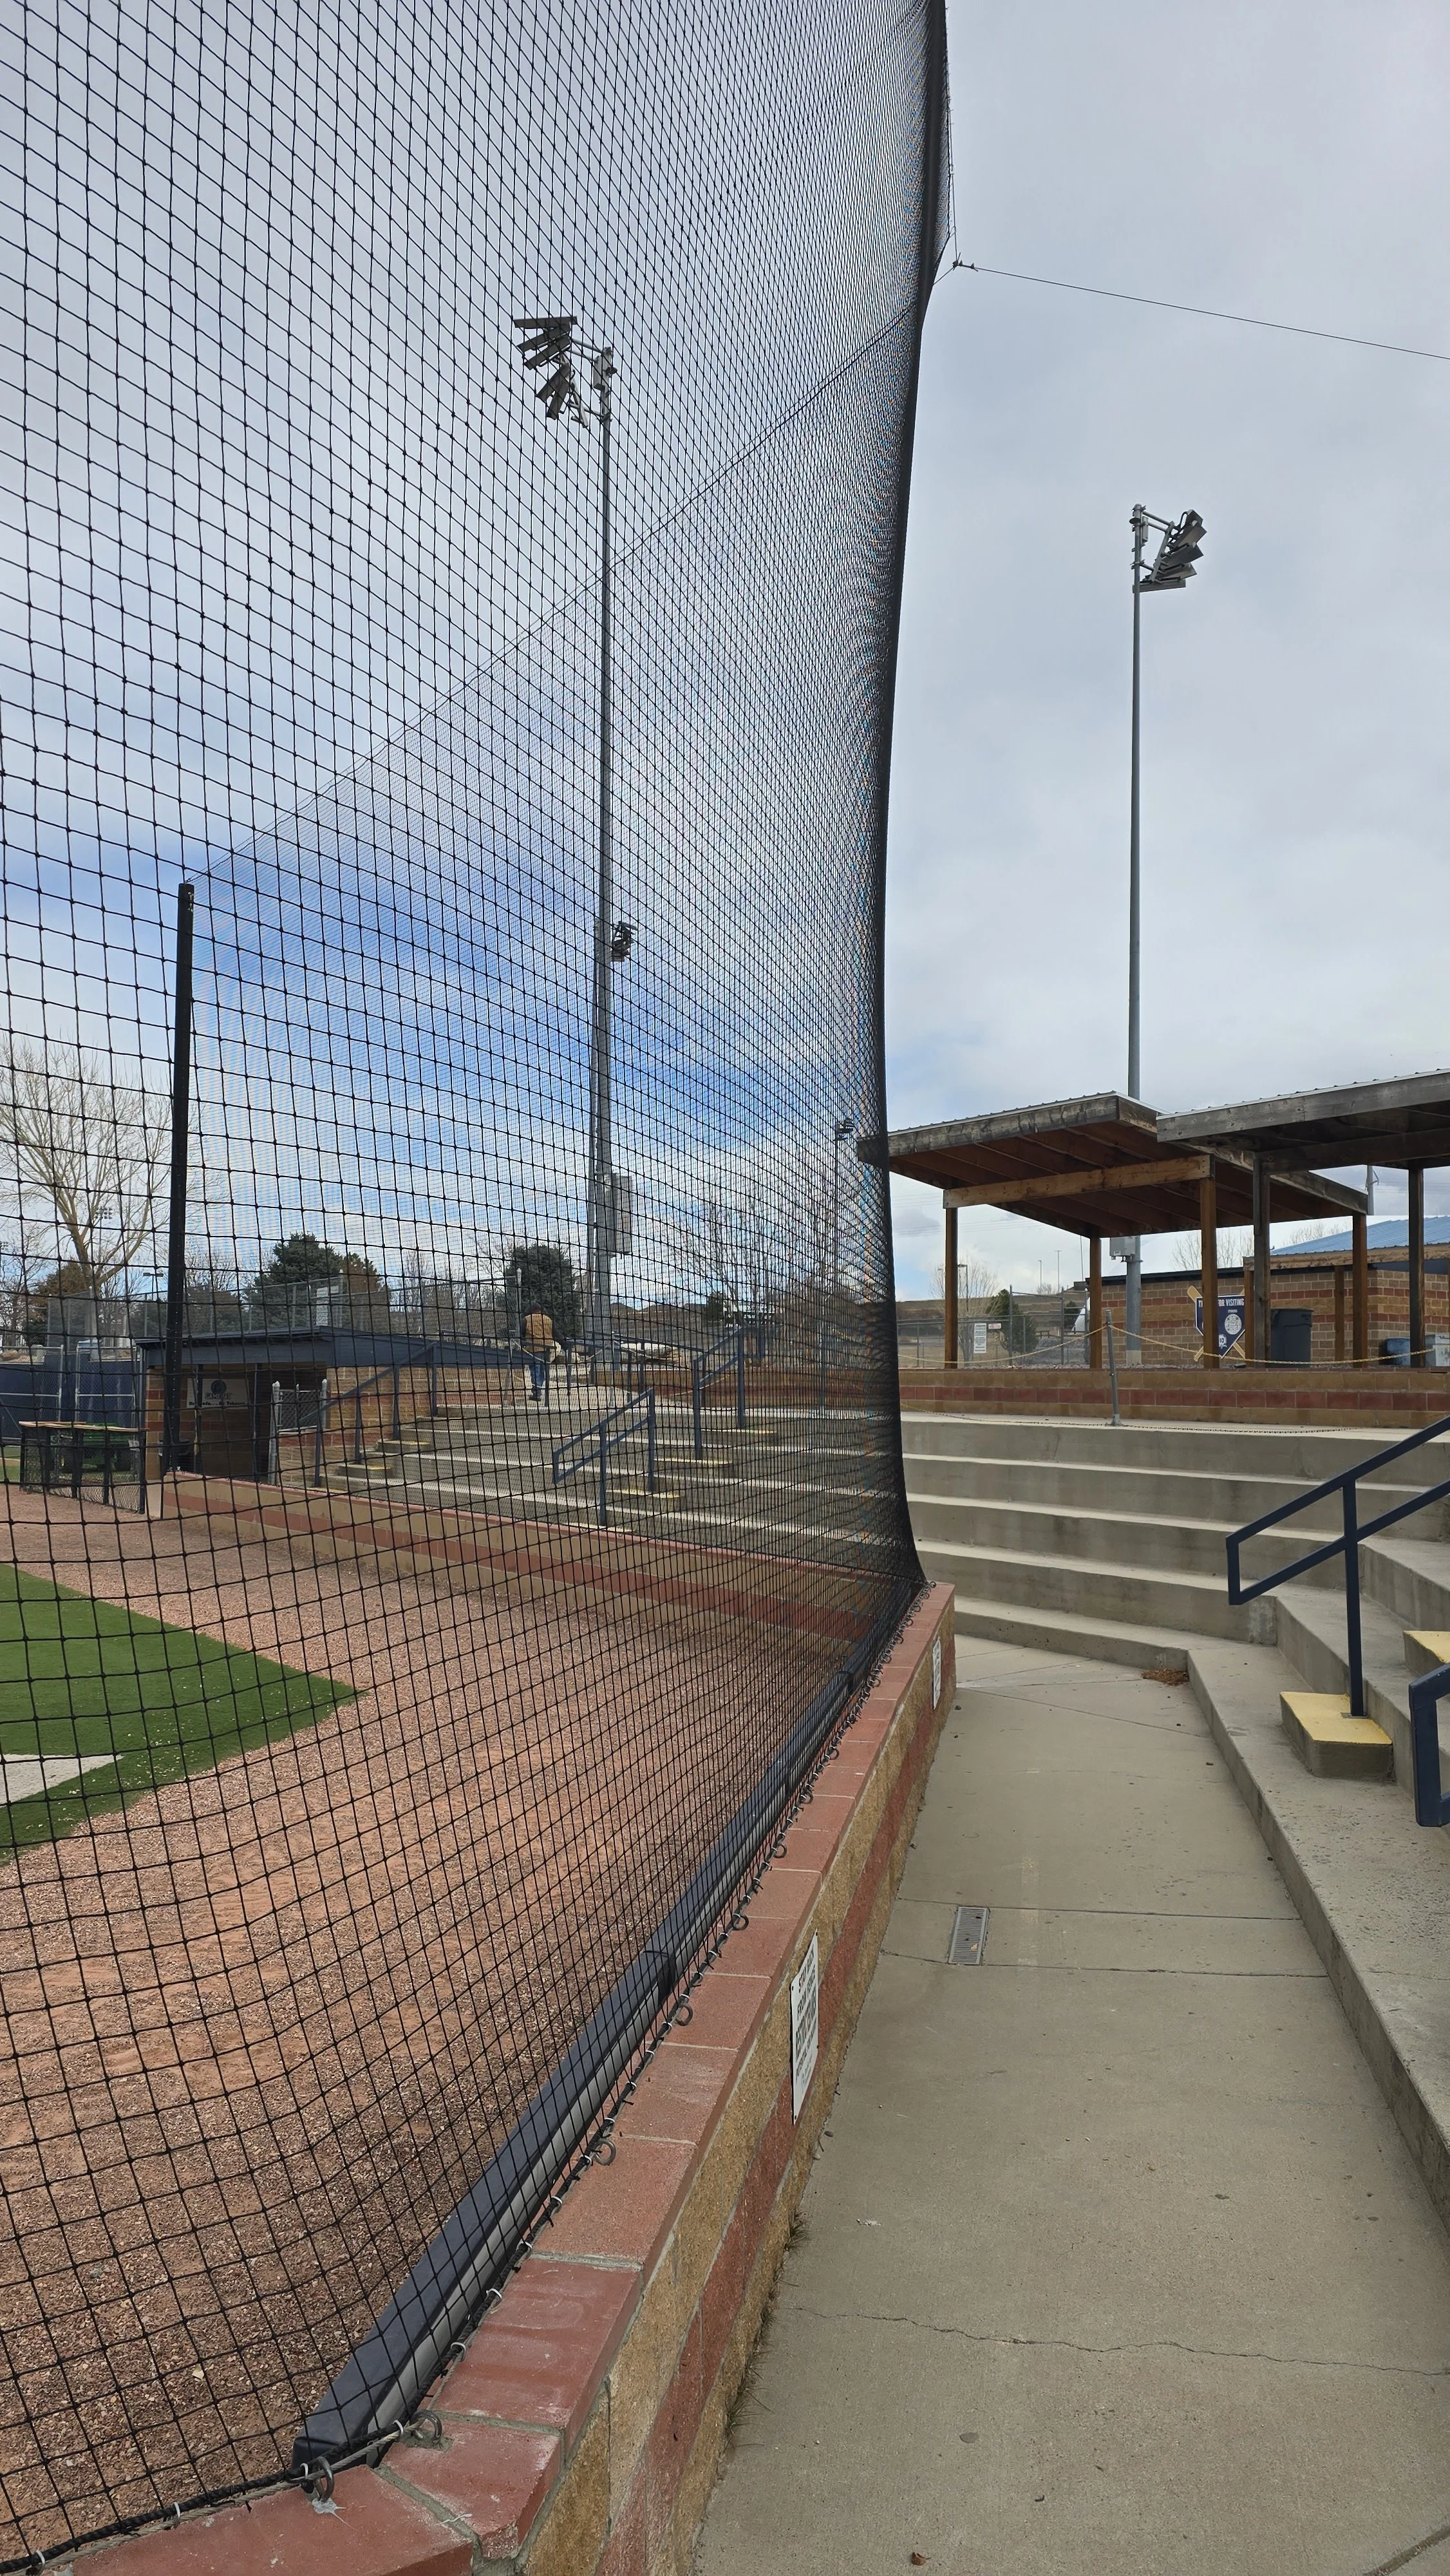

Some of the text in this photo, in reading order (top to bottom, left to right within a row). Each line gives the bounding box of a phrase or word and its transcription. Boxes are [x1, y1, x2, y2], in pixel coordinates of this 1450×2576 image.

[1225, 1298, 1245, 1307] VISITING
[797, 1988, 807, 2021] FROM
[807, 1964, 816, 1999] FENCE
[798, 1964, 807, 1993] STAY
